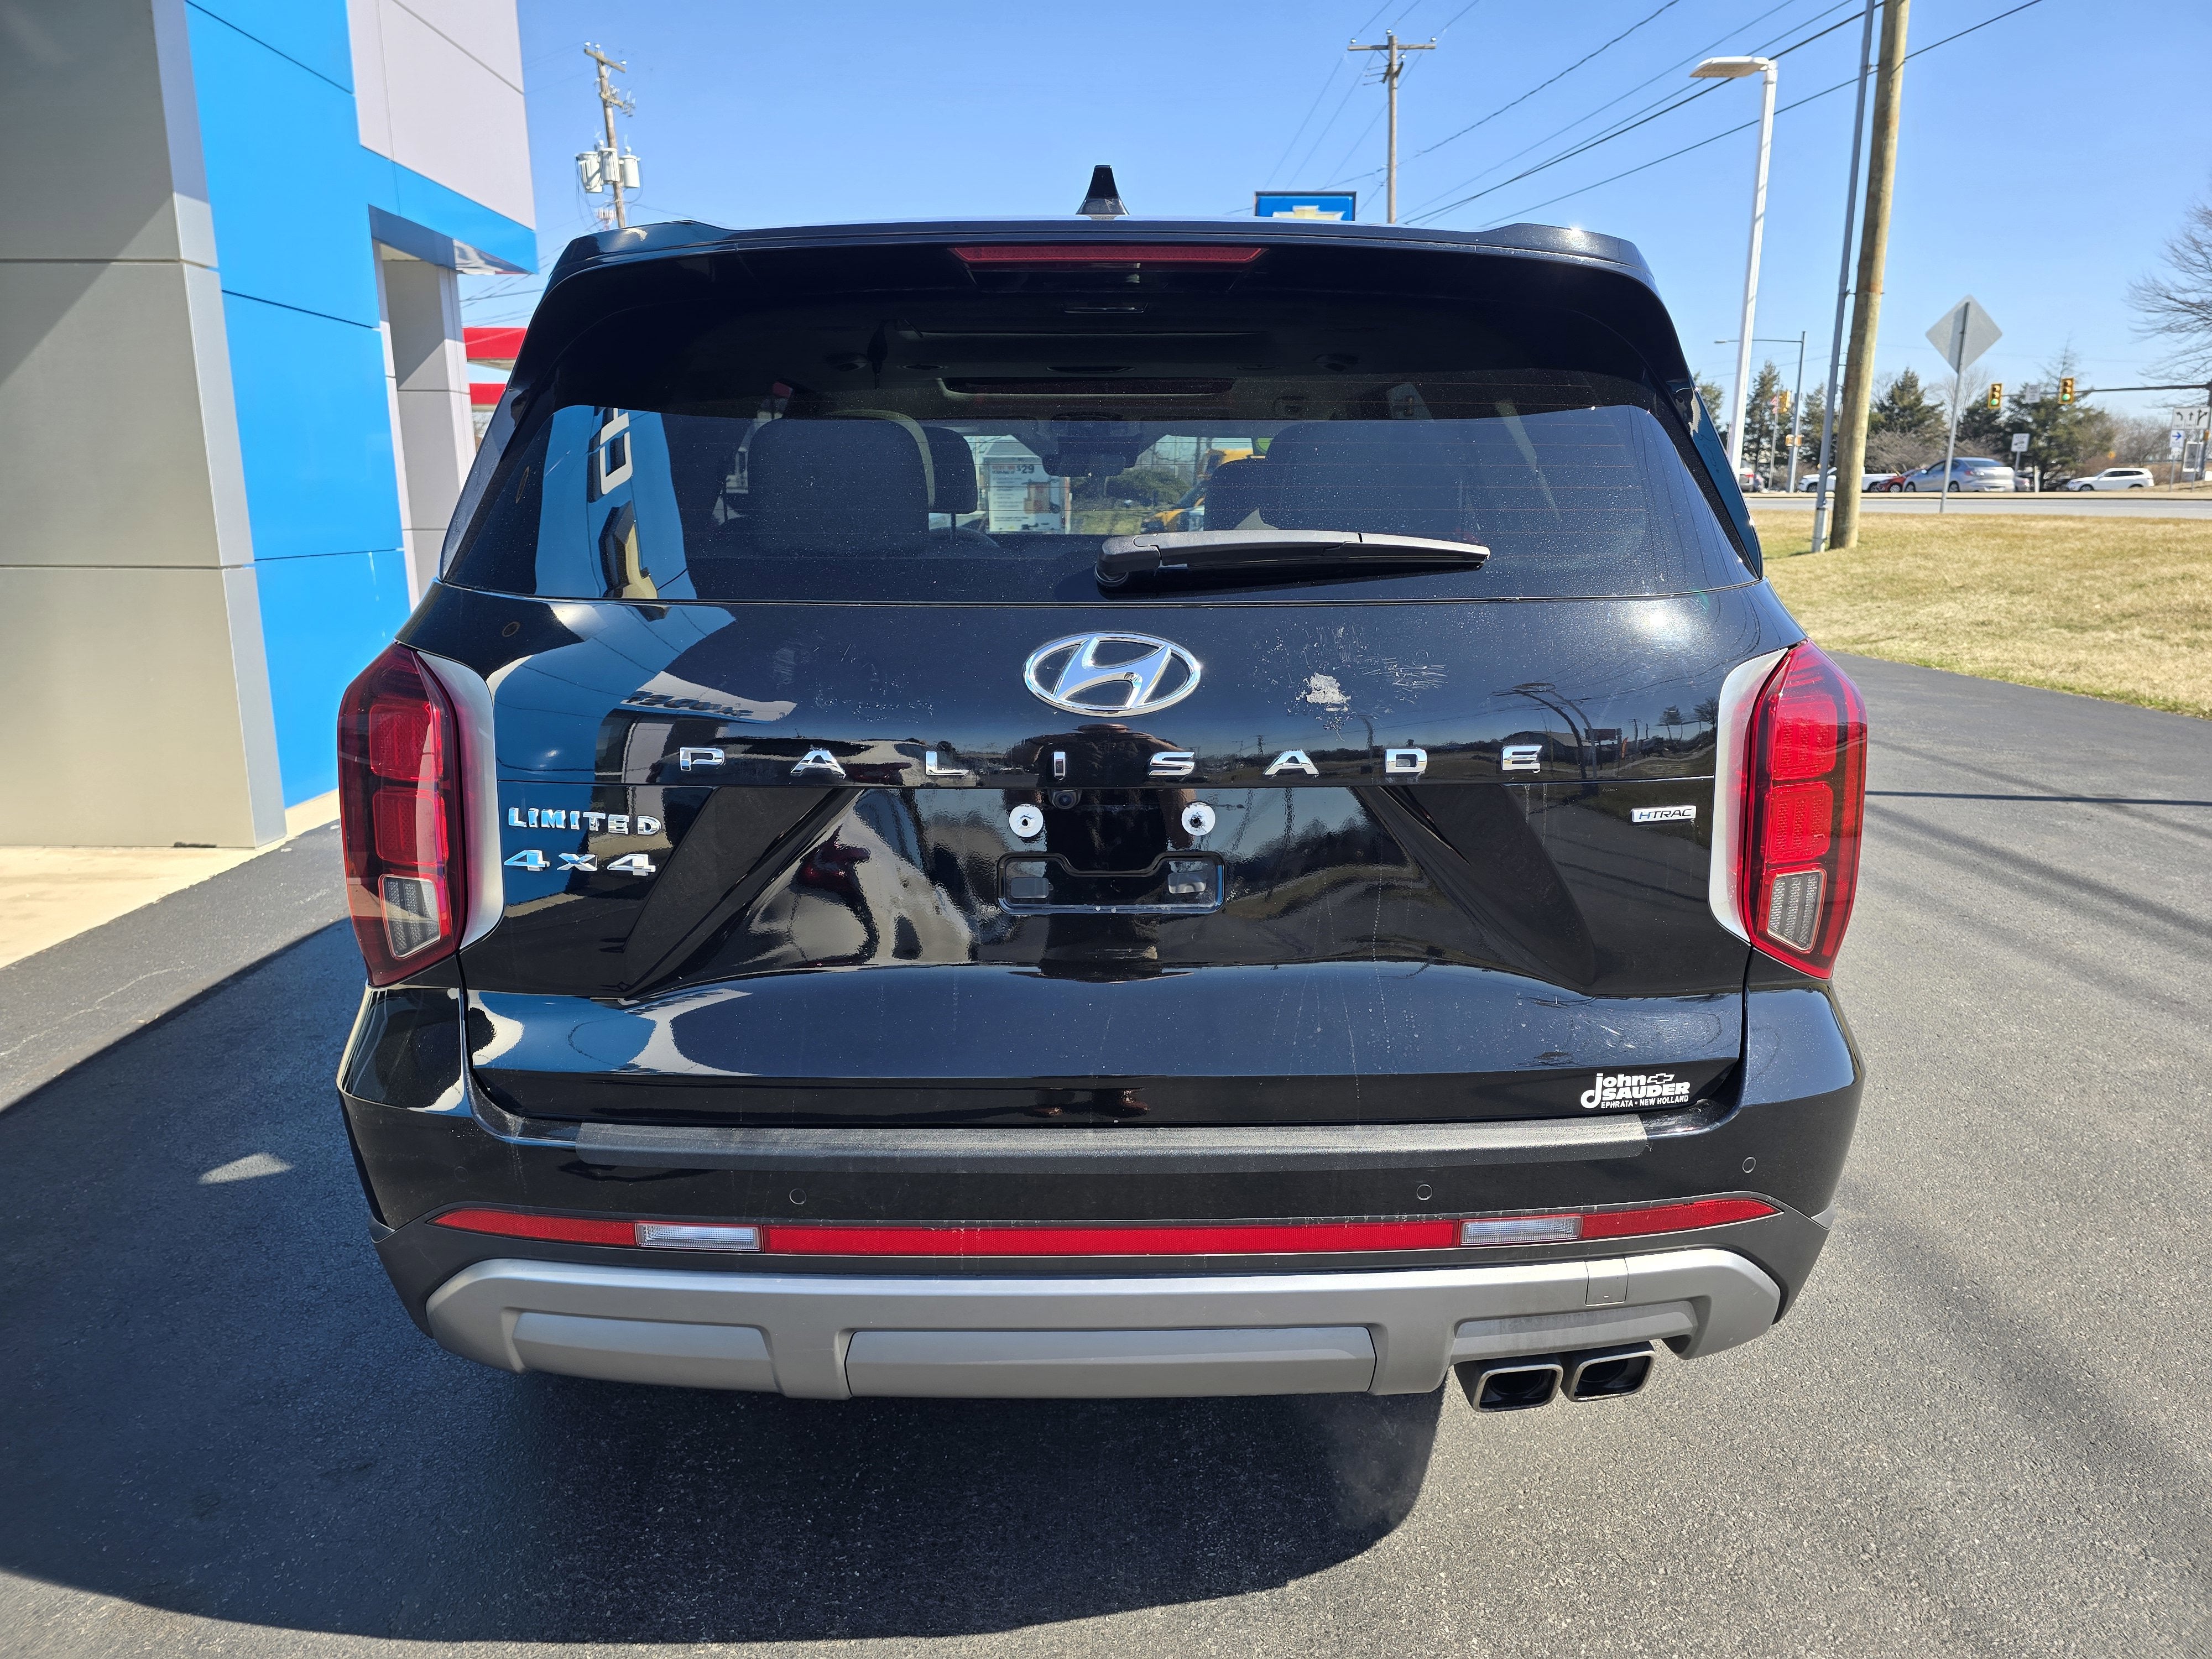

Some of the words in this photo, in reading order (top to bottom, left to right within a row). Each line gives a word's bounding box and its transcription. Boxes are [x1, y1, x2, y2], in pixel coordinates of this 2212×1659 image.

[680, 745, 1542, 779] PALISADE
[508, 807, 662, 836] LIMITED
[1639, 808, 1692, 820] HTRAC
[1602, 1082, 1691, 1101] SAUDER
[1601, 1100, 1634, 1109] EPHRATA
[1640, 1098, 1655, 1107] NEW
[1657, 1095, 1689, 1105] HOLLAND
